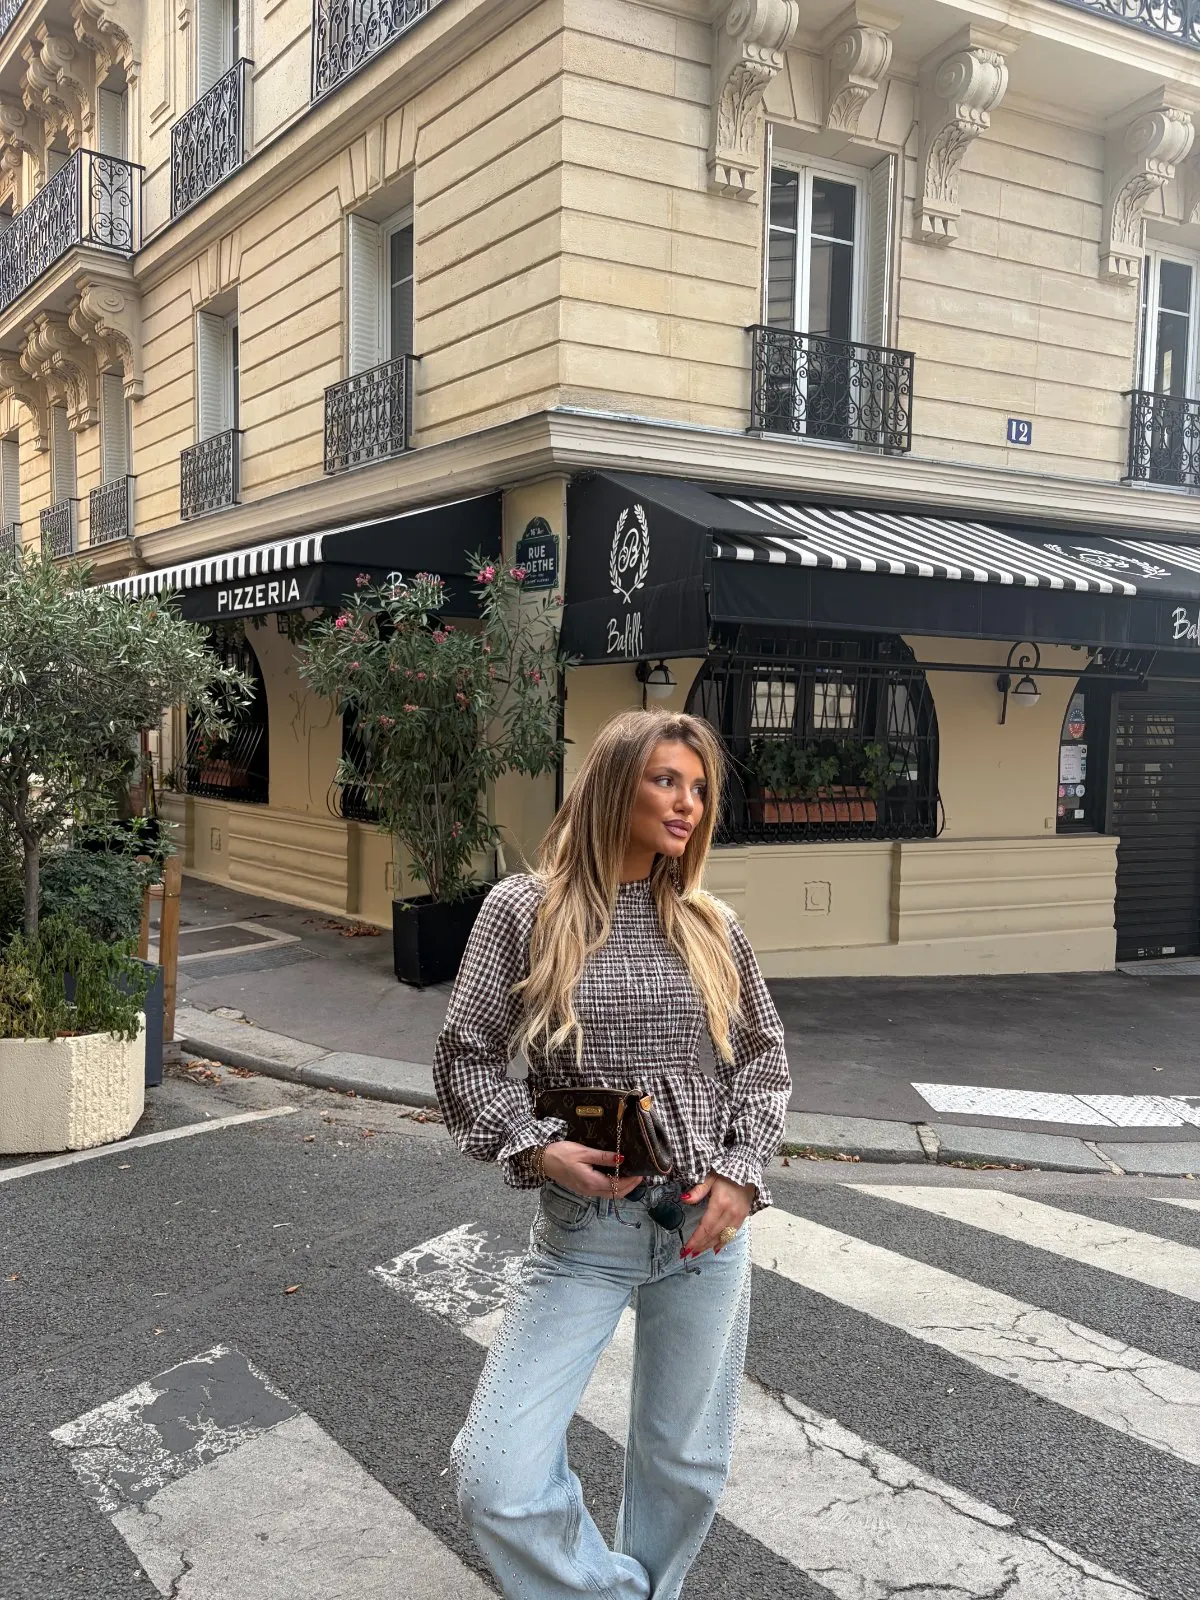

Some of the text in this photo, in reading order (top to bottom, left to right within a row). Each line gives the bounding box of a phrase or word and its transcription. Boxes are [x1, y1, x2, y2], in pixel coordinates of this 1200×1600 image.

[1011, 420, 1028, 442] 12
[528, 545, 546, 559] RUE
[618, 528, 641, 573] B
[217, 578, 300, 612] PIZZERIA
